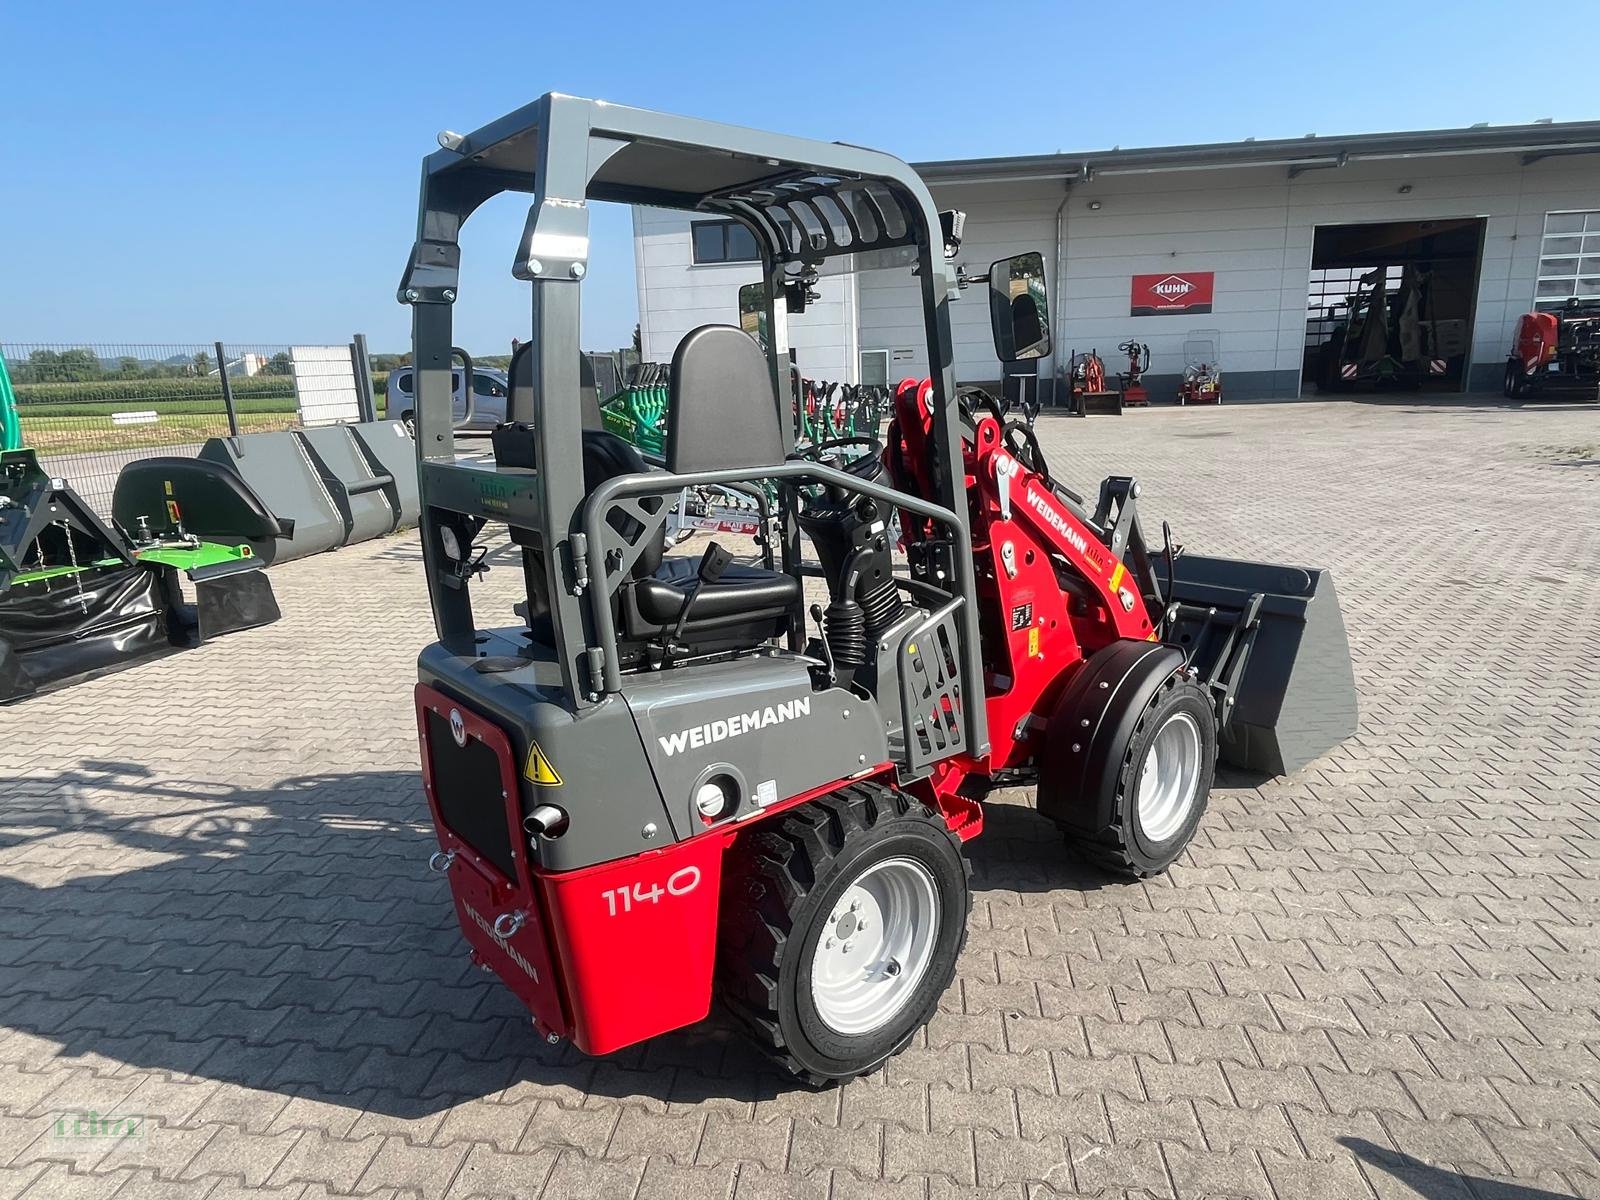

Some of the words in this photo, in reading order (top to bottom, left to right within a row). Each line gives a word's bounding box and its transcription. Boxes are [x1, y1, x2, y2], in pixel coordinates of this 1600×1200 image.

[1156, 283, 1189, 294] KUHN
[1026, 486, 1087, 555] WEIDEMANN
[658, 696, 811, 757] WEIDEMANN
[601, 865, 701, 917] 1140
